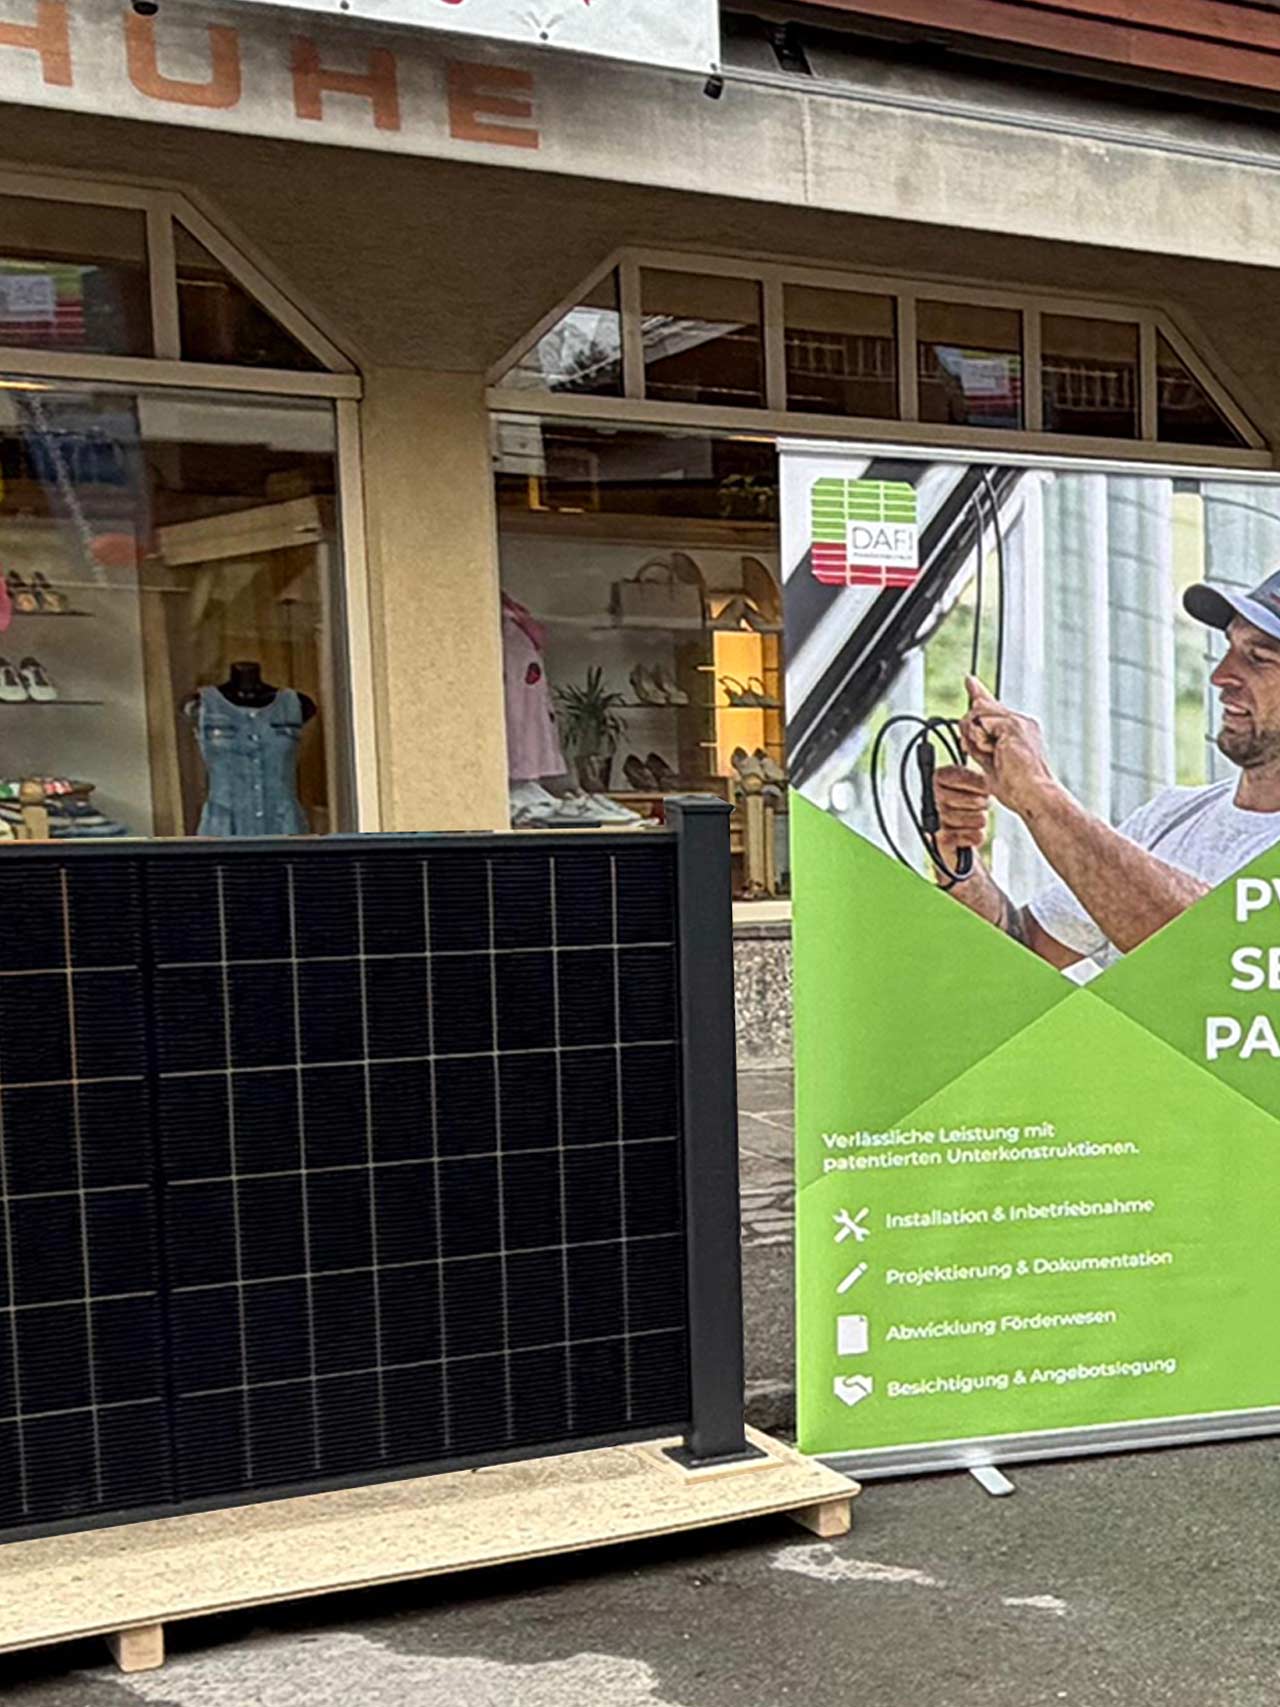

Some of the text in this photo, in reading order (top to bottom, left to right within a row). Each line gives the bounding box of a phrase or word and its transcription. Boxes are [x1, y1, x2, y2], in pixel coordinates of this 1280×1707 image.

[852, 526, 914, 551] DAFI
[822, 1121, 1055, 1149] Verlässliche Leistung mit
[823, 1141, 1140, 1173] patentierten Unterkonstruktionen.
[886, 1198, 1155, 1229] Installation & Inbetriebnahme
[886, 1250, 1173, 1287] Projektierung & Dokumentation
[886, 1309, 1117, 1342] Abwicklung Förderwesen
[887, 1356, 1177, 1398] Besichtigung & Angebotslegung
